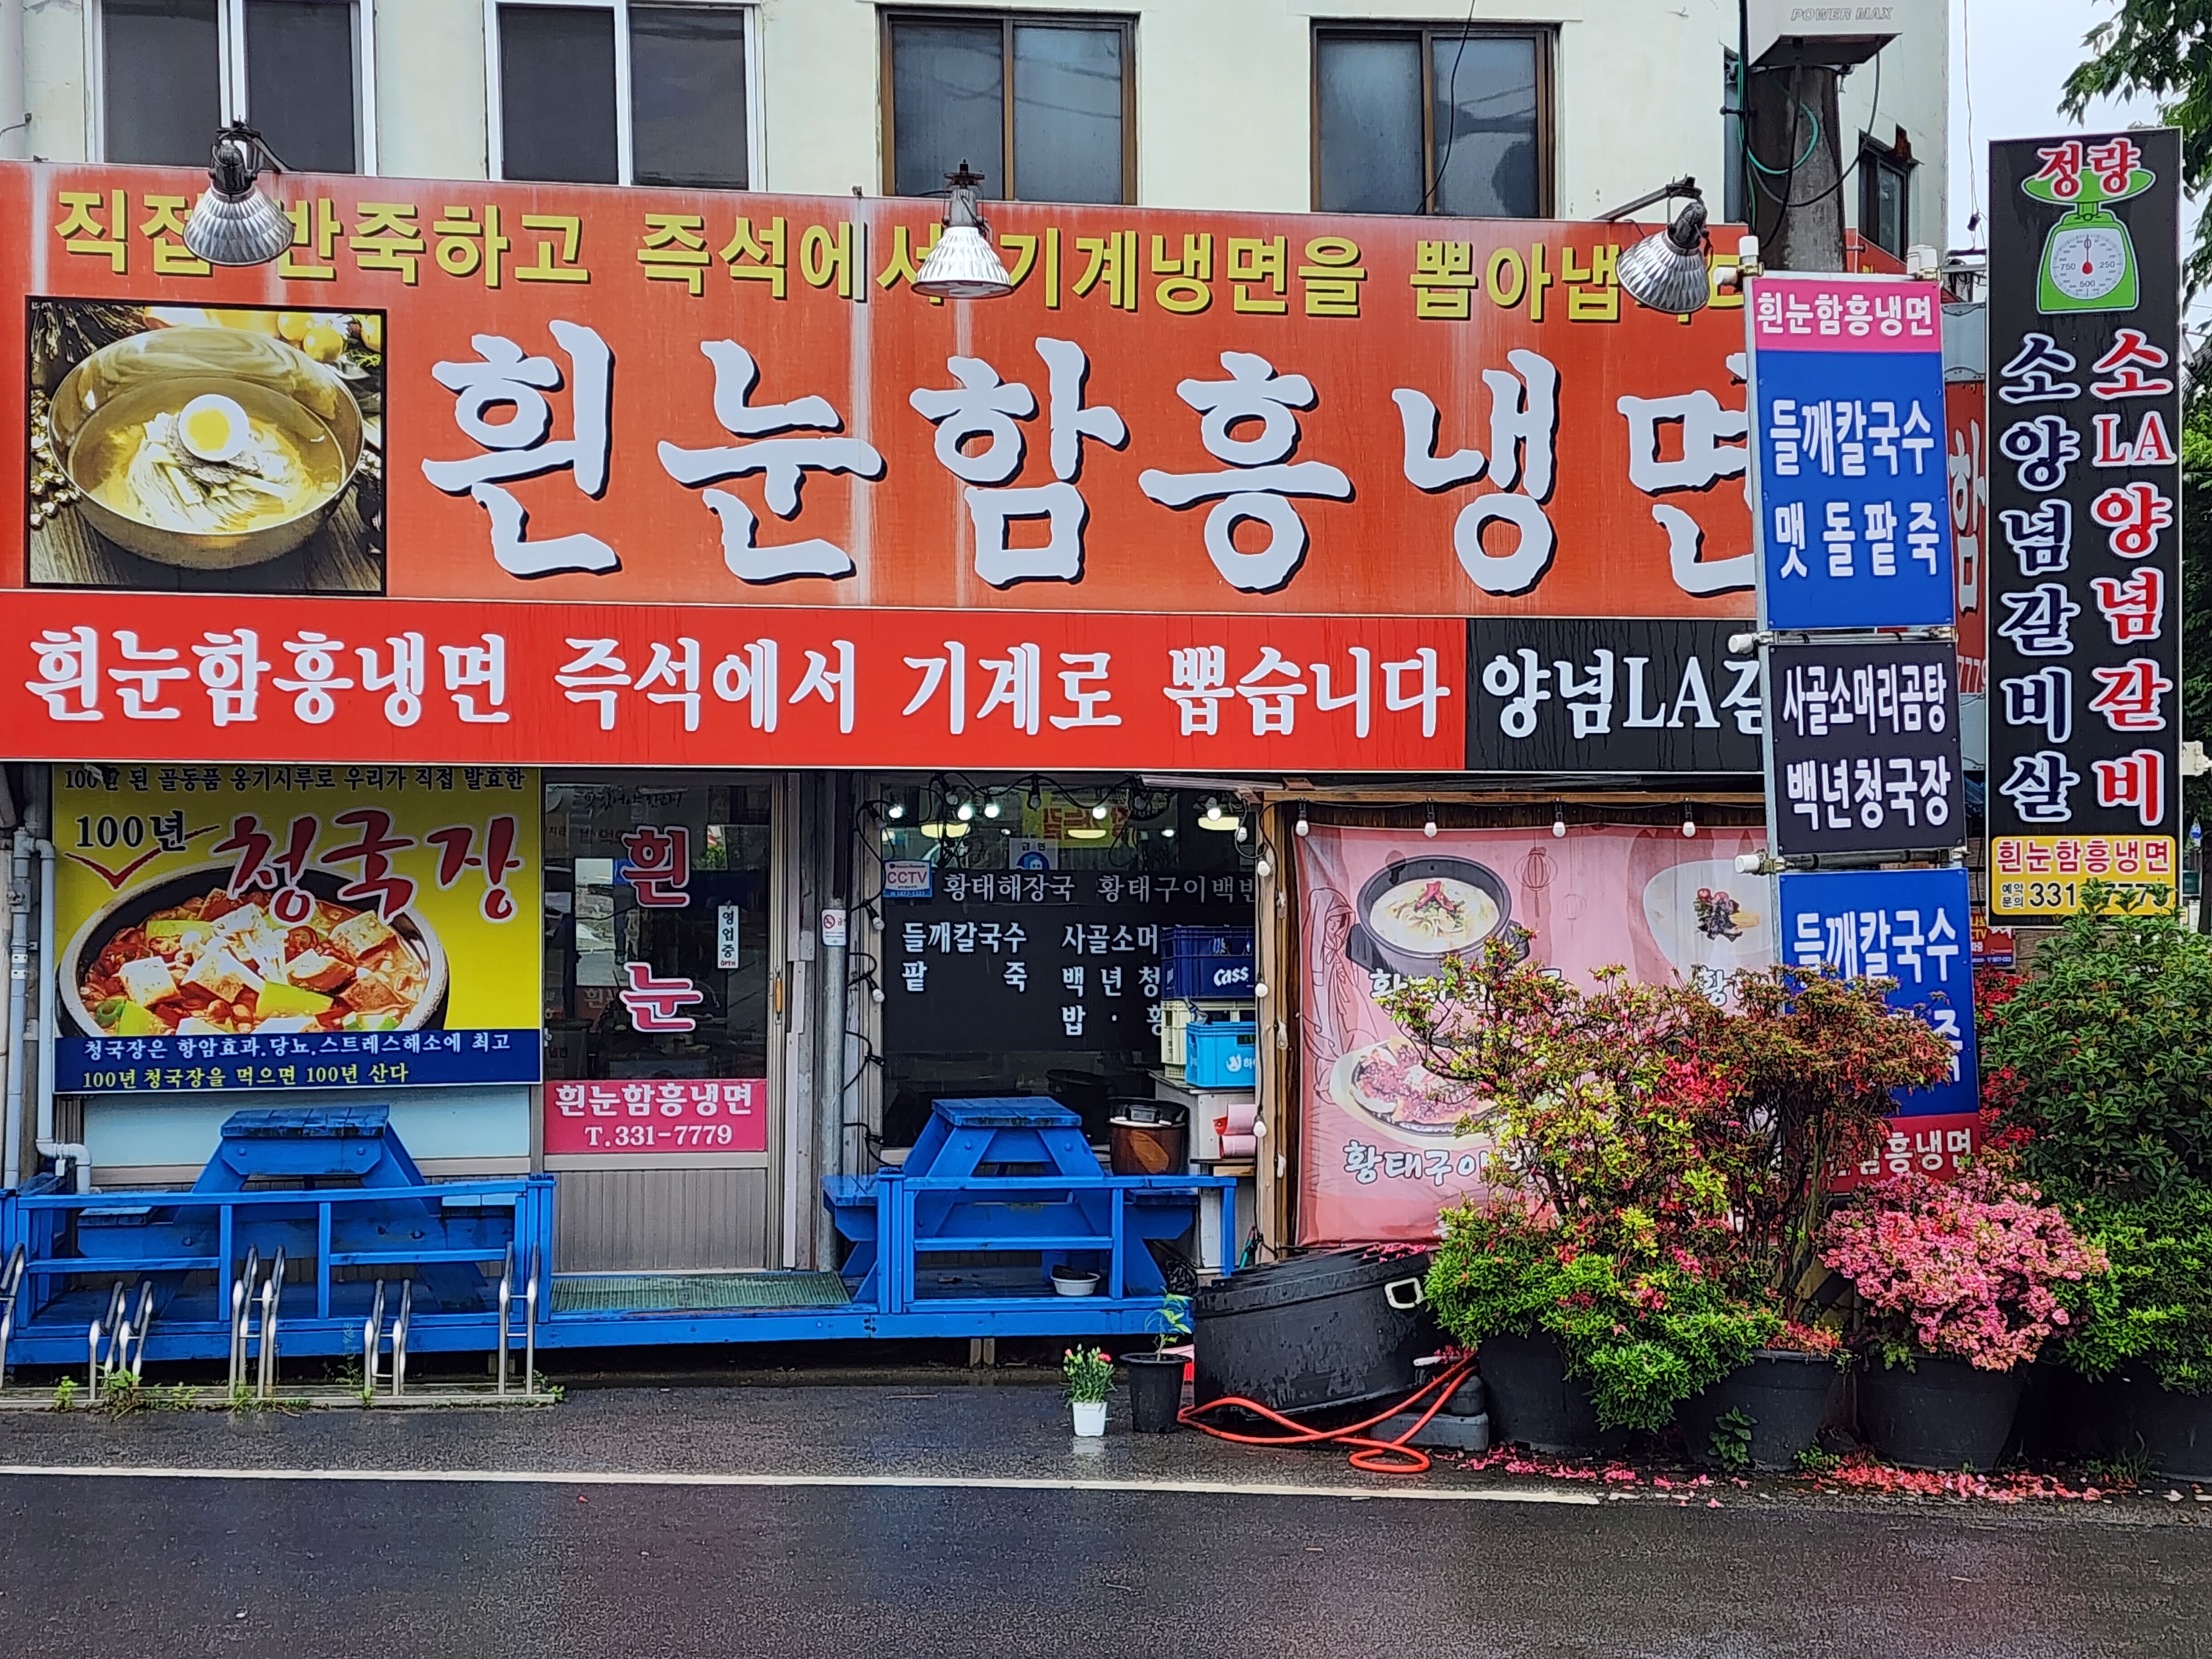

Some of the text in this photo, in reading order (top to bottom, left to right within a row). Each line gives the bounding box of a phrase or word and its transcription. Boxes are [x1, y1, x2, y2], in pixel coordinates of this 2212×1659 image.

[1791, 7, 1893, 21] POWER MAX
[2036, 138, 2141, 200] 정량
[1000, 227, 1367, 317] 기계냉면을
[1410, 240, 1744, 323] 뽑아냅
[1757, 291, 1933, 336] 흰눈함흥냉면
[1770, 399, 1934, 476] 들깨칼국수
[421, 320, 1756, 597] 흰눈함흥냉면
[25, 625, 1451, 739] 흰눈함흥냉면 즉석에서 기계로 뽑습니다
[1783, 663, 1947, 737] 사골소머리곰탕
[128, 766, 149, 791] 된
[158, 767, 222, 791] 골동품
[229, 766, 336, 792] 옹기시루로
[343, 767, 407, 791] 우리가
[415, 768, 453, 791] 직접
[463, 768, 525, 791] 발효한
[1786, 755, 1951, 831] 백년청국장
[75, 808, 523, 924] 100년 청국장
[1997, 839, 2170, 875] 흰눈함흥냉면
[887, 871, 927, 884] CCTV
[942, 873, 1076, 902] 황태해장국
[2002, 896, 2024, 907] 문의
[721, 908, 735, 958] 영업중
[902, 921, 1027, 953] 들깨칼국수
[1794, 907, 1959, 984] 들깨칼국수
[1213, 966, 1249, 987] Cass
[84, 1038, 168, 1061] 청국장은
[471, 1032, 511, 1053] 최고
[82, 1062, 409, 1089] 100년 청국장을 먹으면 100년 산다
[555, 1082, 752, 1118] 흰눈함흥냉면
[584, 1124, 733, 1147] T.331-7779
